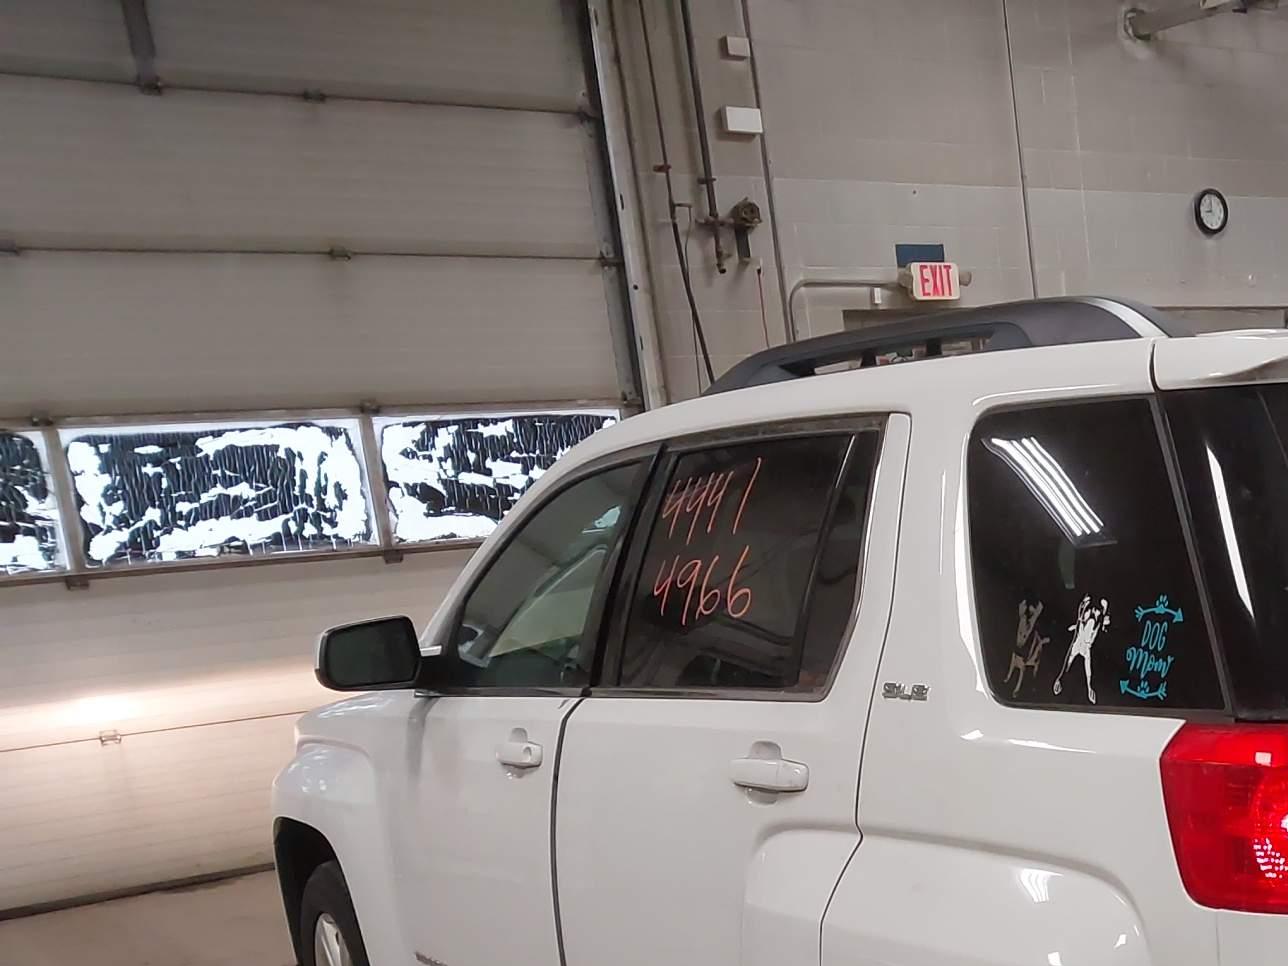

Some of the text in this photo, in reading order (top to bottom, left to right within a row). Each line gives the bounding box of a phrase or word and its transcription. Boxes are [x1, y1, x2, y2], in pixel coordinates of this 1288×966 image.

[919, 264, 952, 297] EXIT
[663, 457, 762, 545] 4441
[654, 545, 751, 626] 4966
[1141, 619, 1169, 652] DOG
[882, 682, 929, 701] SLE
